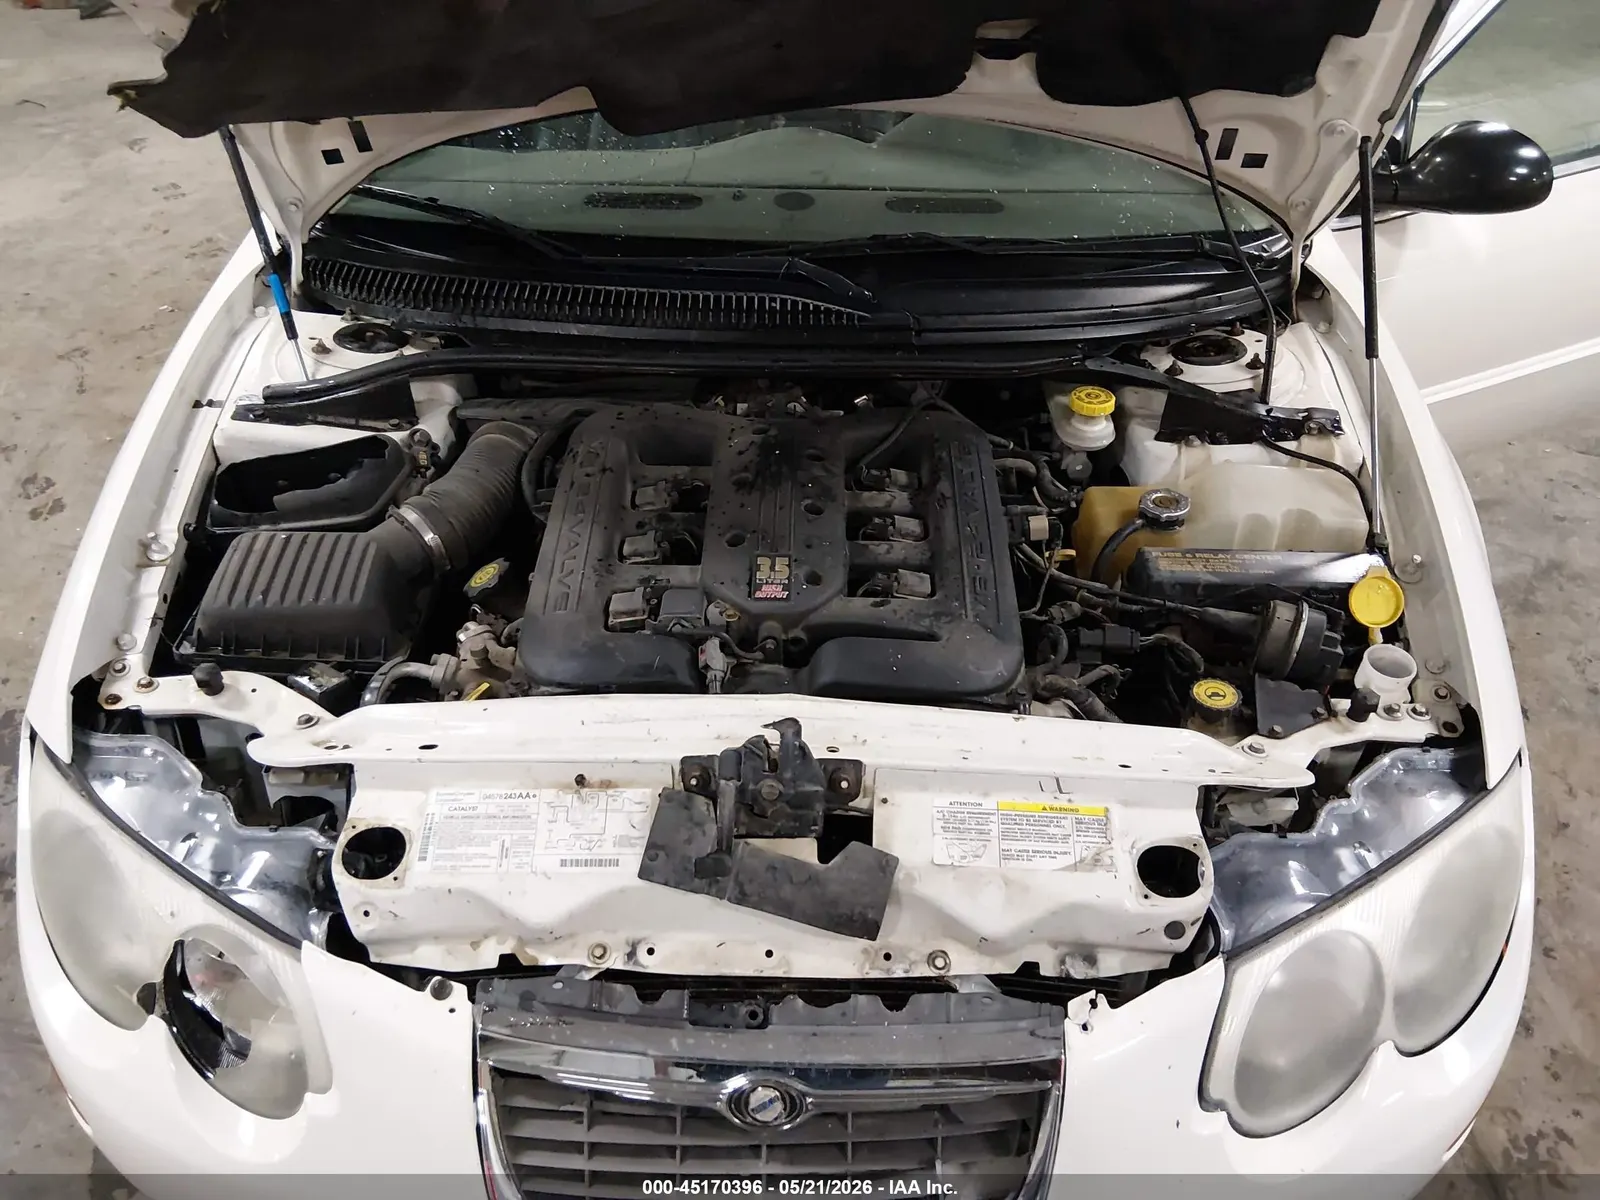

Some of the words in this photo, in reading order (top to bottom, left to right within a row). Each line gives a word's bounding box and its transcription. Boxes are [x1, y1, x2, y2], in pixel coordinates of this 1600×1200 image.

[1195, 552, 1231, 560] RELAY
[756, 556, 790, 579] 3.5
[761, 584, 784, 592] HIGH
[754, 591, 789, 599] OUTPUT
[1049, 805, 1080, 813] WARNING
